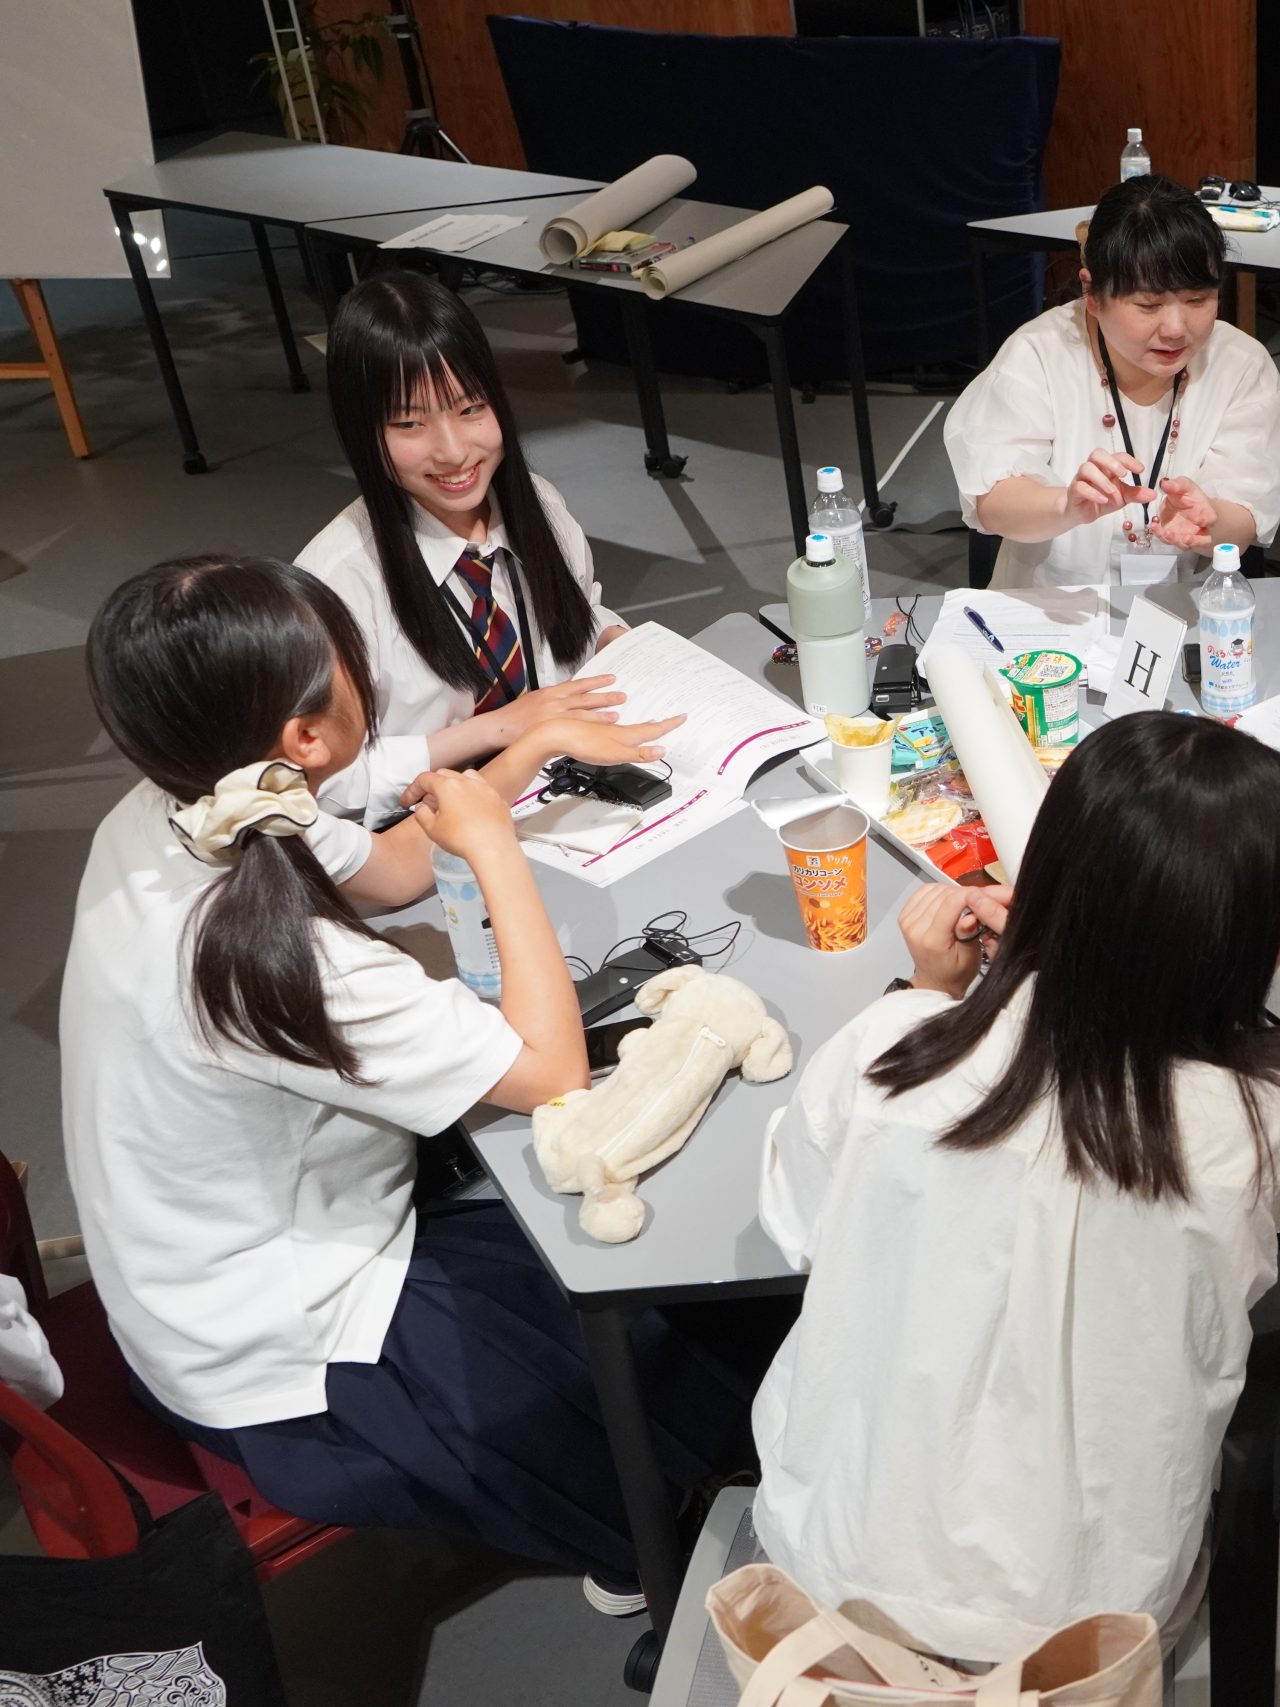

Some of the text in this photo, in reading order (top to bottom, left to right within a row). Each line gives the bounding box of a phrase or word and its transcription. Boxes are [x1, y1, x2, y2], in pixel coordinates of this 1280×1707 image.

[1124, 640, 1161, 697] H
[1209, 655, 1240, 670] Water
[793, 865, 842, 877] カリカリコーン
[795, 875, 847, 891] コンソメ
